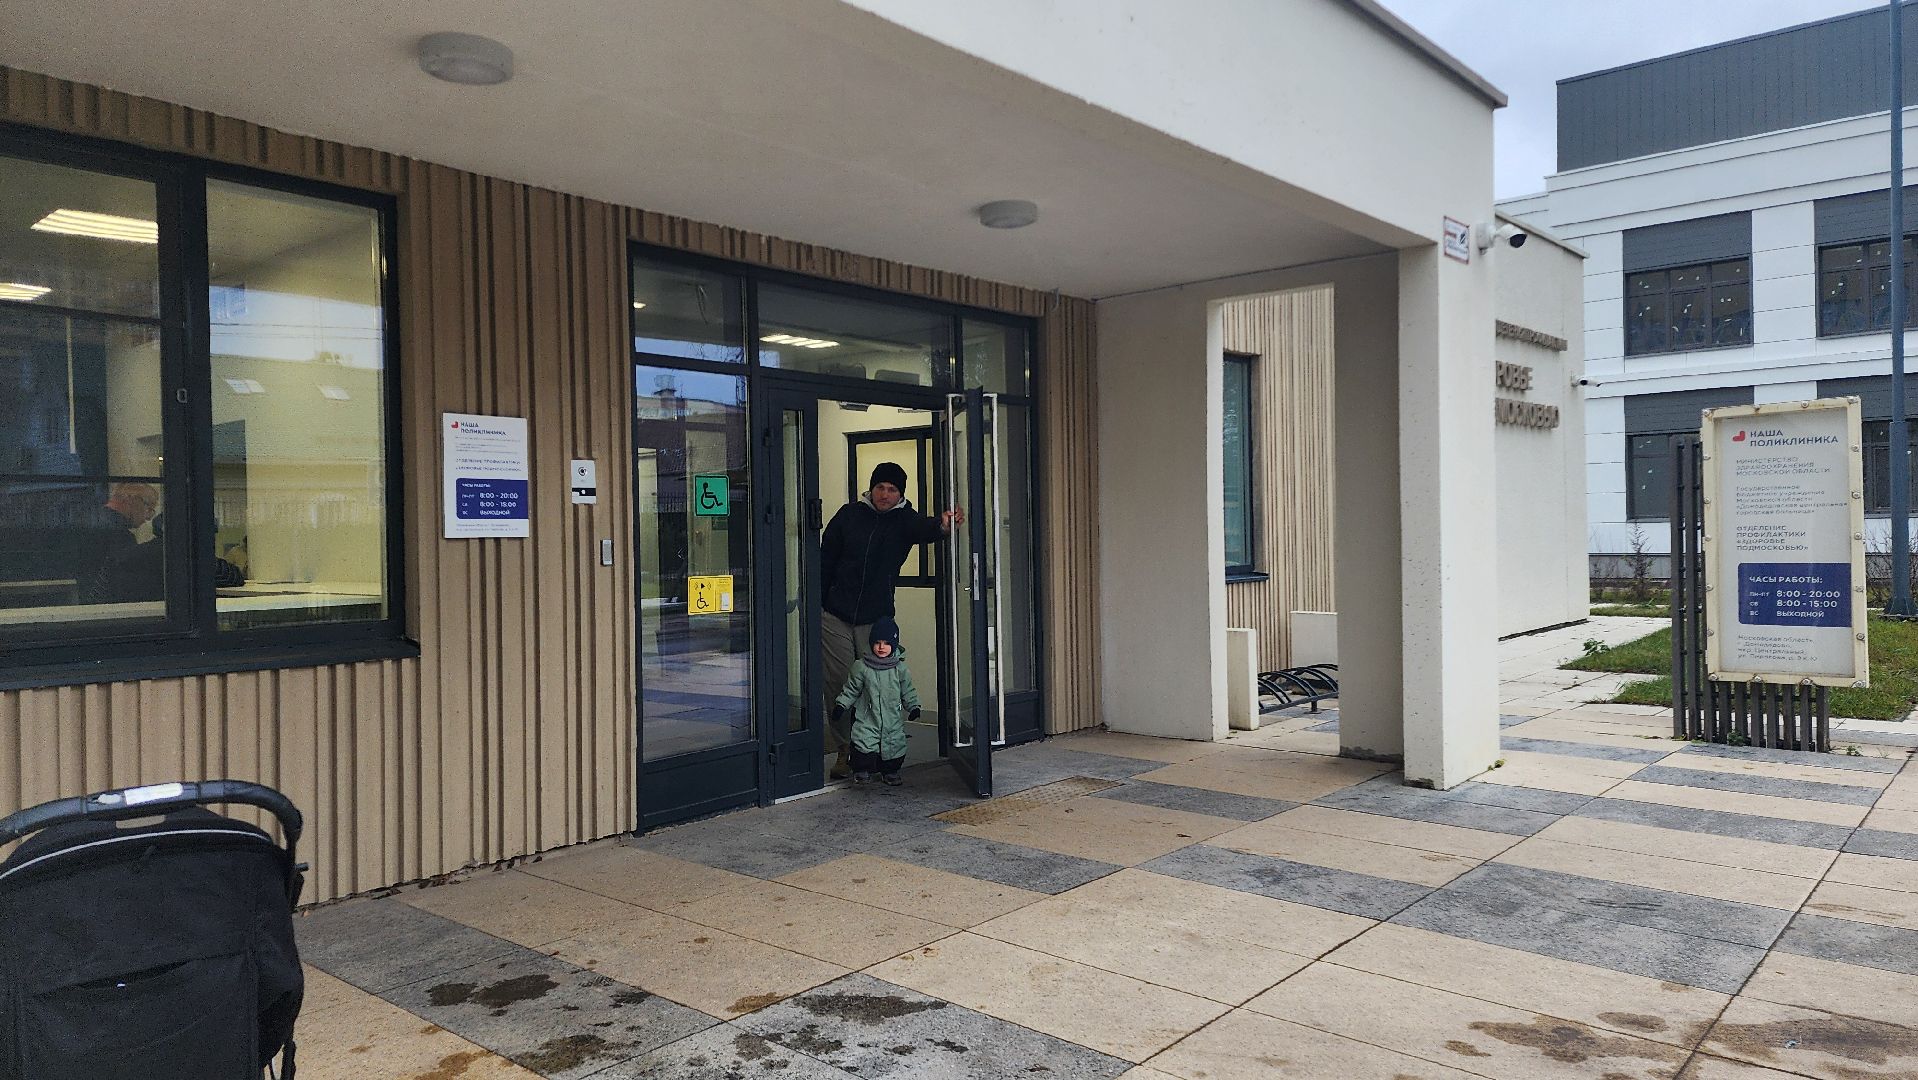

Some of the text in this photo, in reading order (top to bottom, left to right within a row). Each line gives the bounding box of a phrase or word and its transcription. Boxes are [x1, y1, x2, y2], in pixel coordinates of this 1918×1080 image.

[461, 428, 506, 436] ПОЛИКЛИНИКА
[1750, 429, 1783, 438] НАША
[1750, 435, 1839, 447] ПОЛИКЛИНИКА
[1736, 456, 1799, 464] МИНИСТЕРСТВО
[1736, 462, 1815, 471] ЗДРАВООХРАНЕНИЯ
[1778, 576, 1823, 584] РАБОТЫ:
[1776, 590, 1800, 598] 8:00
[1809, 590, 1840, 598] 20:00
[1809, 600, 1838, 608] 15:00
[1776, 610, 1825, 618] ВЫХОДНОЙ
